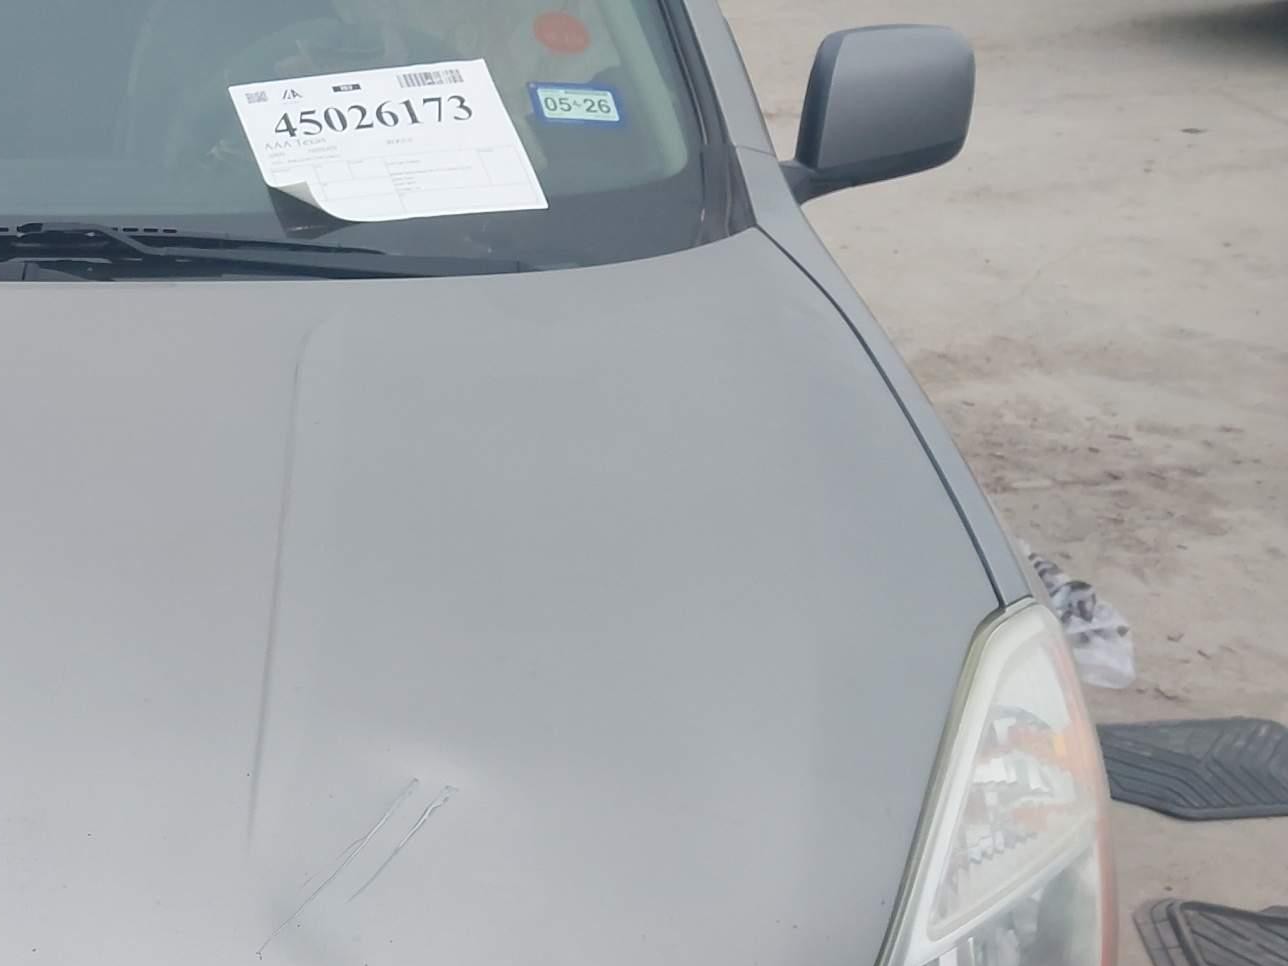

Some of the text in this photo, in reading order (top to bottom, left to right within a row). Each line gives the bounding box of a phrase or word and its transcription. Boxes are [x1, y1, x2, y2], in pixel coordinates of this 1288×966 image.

[274, 94, 473, 138] 45026173
[544, 96, 612, 114] 05 26
